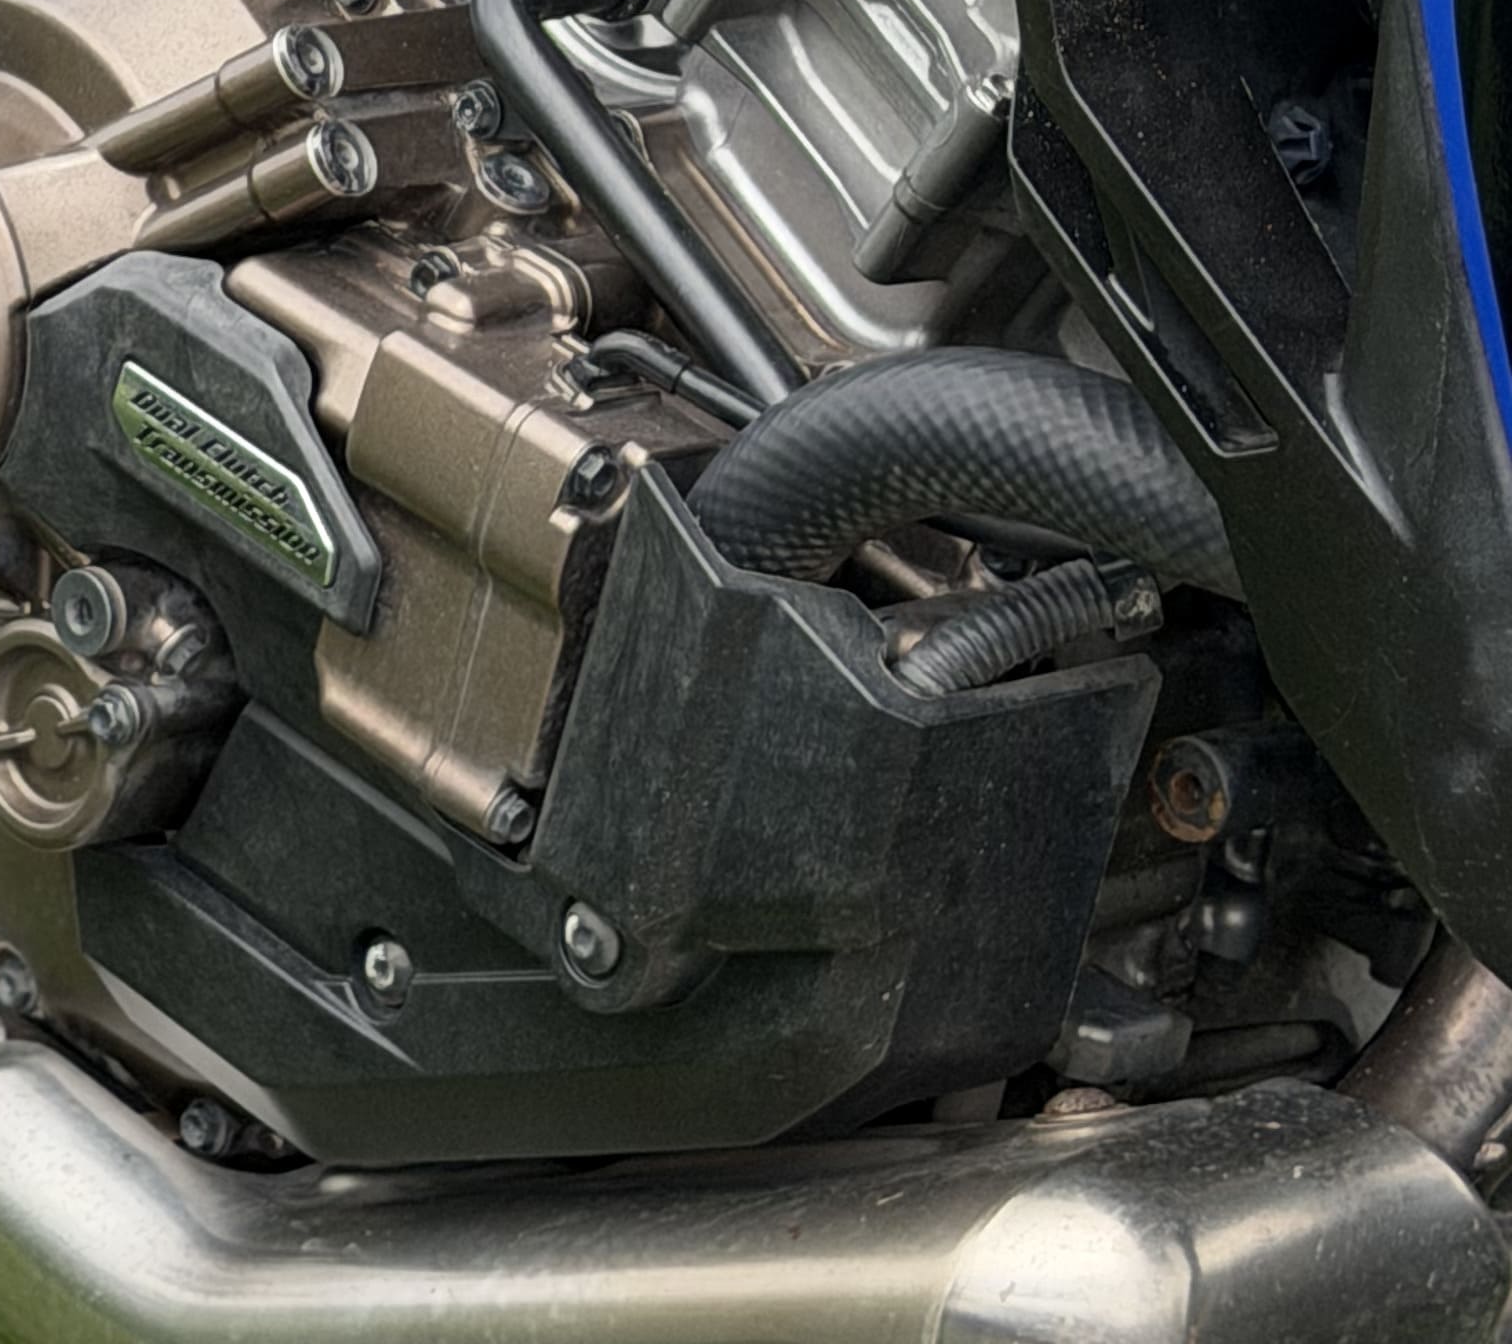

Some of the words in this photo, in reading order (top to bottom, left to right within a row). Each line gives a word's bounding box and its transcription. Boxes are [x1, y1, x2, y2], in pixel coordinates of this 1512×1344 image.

[128, 389, 201, 442] Dual
[198, 437, 291, 509] Clutch
[132, 422, 321, 566] Transmission
